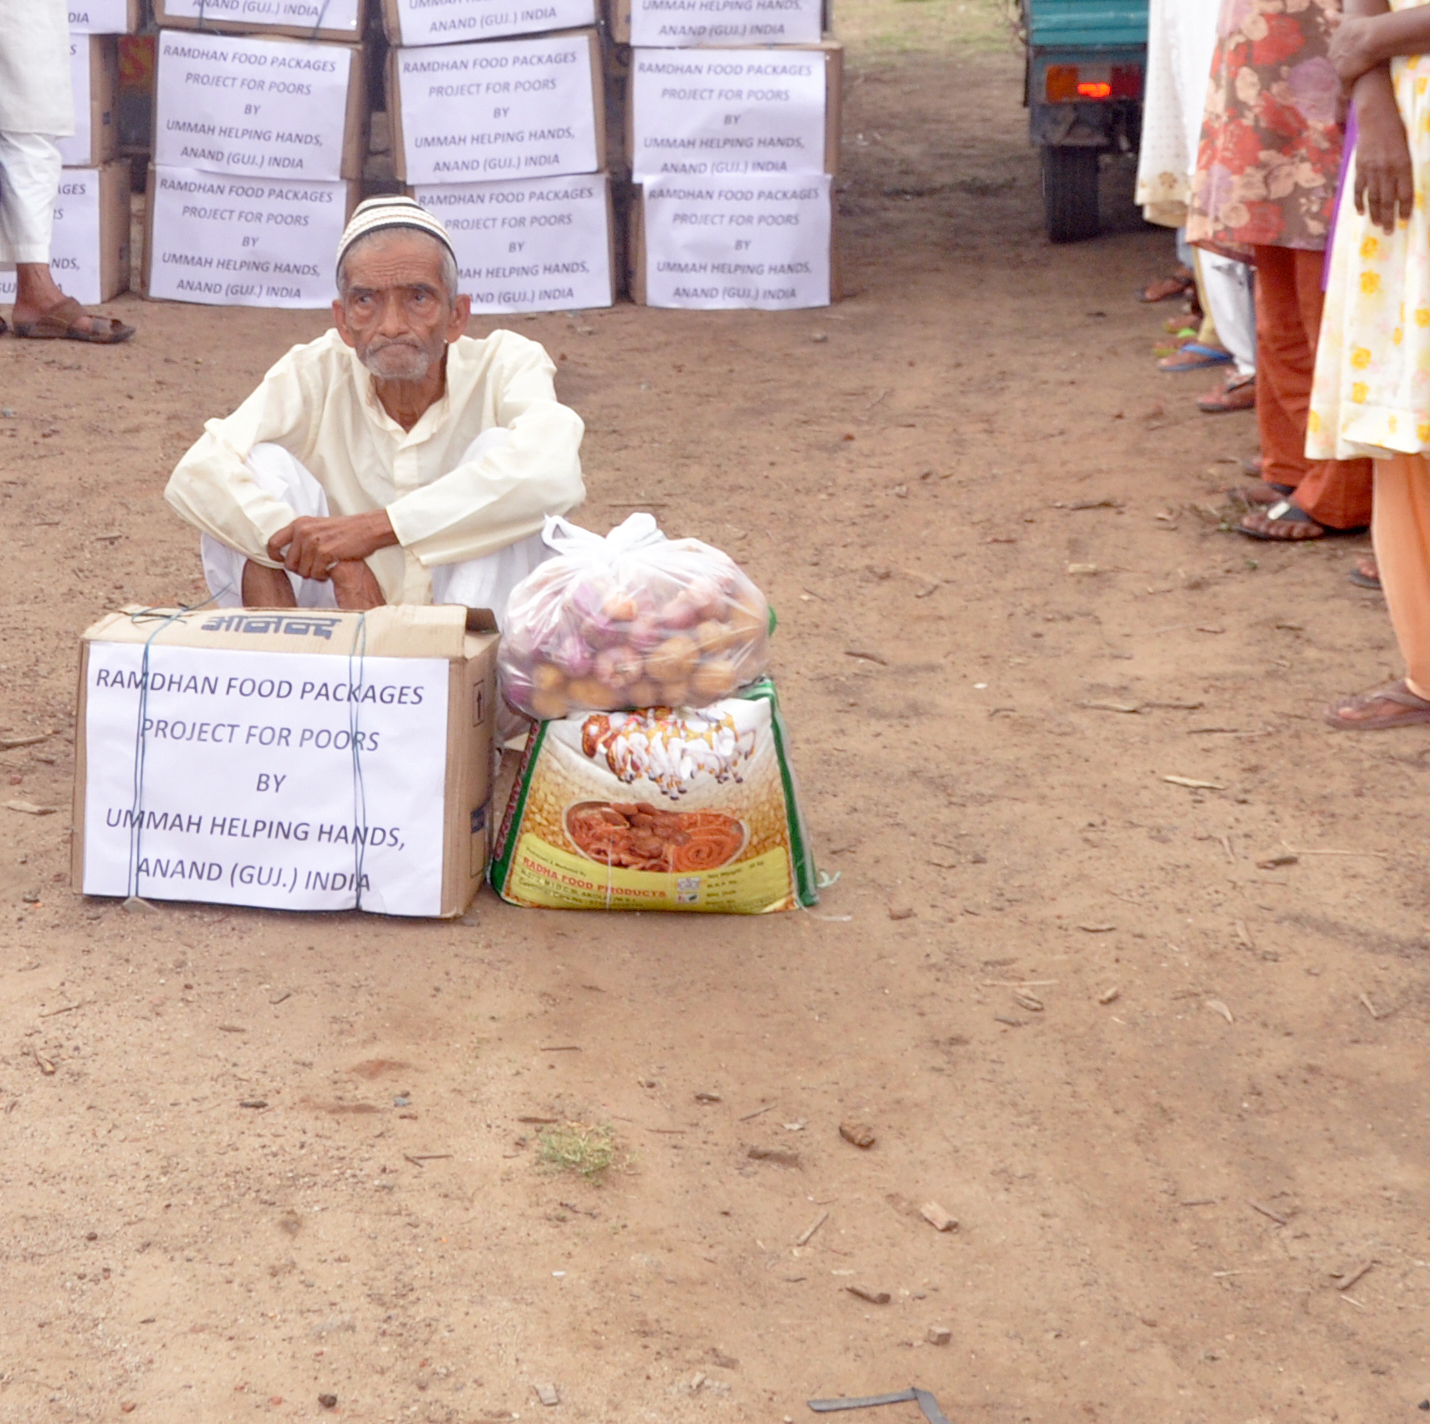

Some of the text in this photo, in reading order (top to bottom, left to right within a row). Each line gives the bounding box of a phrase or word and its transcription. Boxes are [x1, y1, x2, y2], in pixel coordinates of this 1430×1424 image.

[283, 4, 319, 18] INDIA
[429, 17, 477, 32] ANAND
[521, 7, 557, 21] INDIA
[163, 45, 335, 72] RAMDHAN FOOD PACKAGES
[403, 51, 577, 73] RAMDHAN FOOD PACKAGES
[638, 62, 811, 76] RAMDHAN FOOD PACKAGES
[185, 72, 311, 96] PROJECT FOR POORS
[428, 77, 557, 97] PROJECT FOR POORS
[661, 88, 790, 101] PROJECT FOR POORS
[244, 104, 261, 115] BY
[493, 107, 510, 119] BY
[166, 119, 322, 146] UMMAH HELPING HANDS,
[415, 127, 575, 148] UMMAH HELPING HANDS,
[644, 137, 696, 149] UMMAH
[699, 137, 754, 149] HELPING
[180, 146, 224, 162] ANAND
[268, 156, 303, 169] INDIA
[433, 159, 480, 172] ANAND
[524, 153, 560, 166] INDIA
[660, 162, 707, 174] ANAND
[752, 161, 787, 171] INDIA
[160, 178, 332, 203] RAMDHAN FOOD PACKAGES
[182, 205, 309, 227] PROJECT FOR POORS
[242, 236, 259, 247] BY
[162, 253, 320, 276] UMMAH HELPING HANDS,
[176, 279, 223, 294] ANAND
[266, 286, 301, 298] INDIA
[96, 668, 425, 705] RAMDHAN FOOD PACKAGES
[140, 718, 380, 752] PROJECT FOR POORS
[256, 773, 287, 793] BY
[105, 808, 406, 851] UMMAH HELPING HANDS,
[135, 857, 371, 893] ANAND (GUJ.) INDIA
[522, 856, 558, 880] RADHA
[562, 875, 594, 891] FOOD
[597, 884, 667, 898] PRODUCTS
